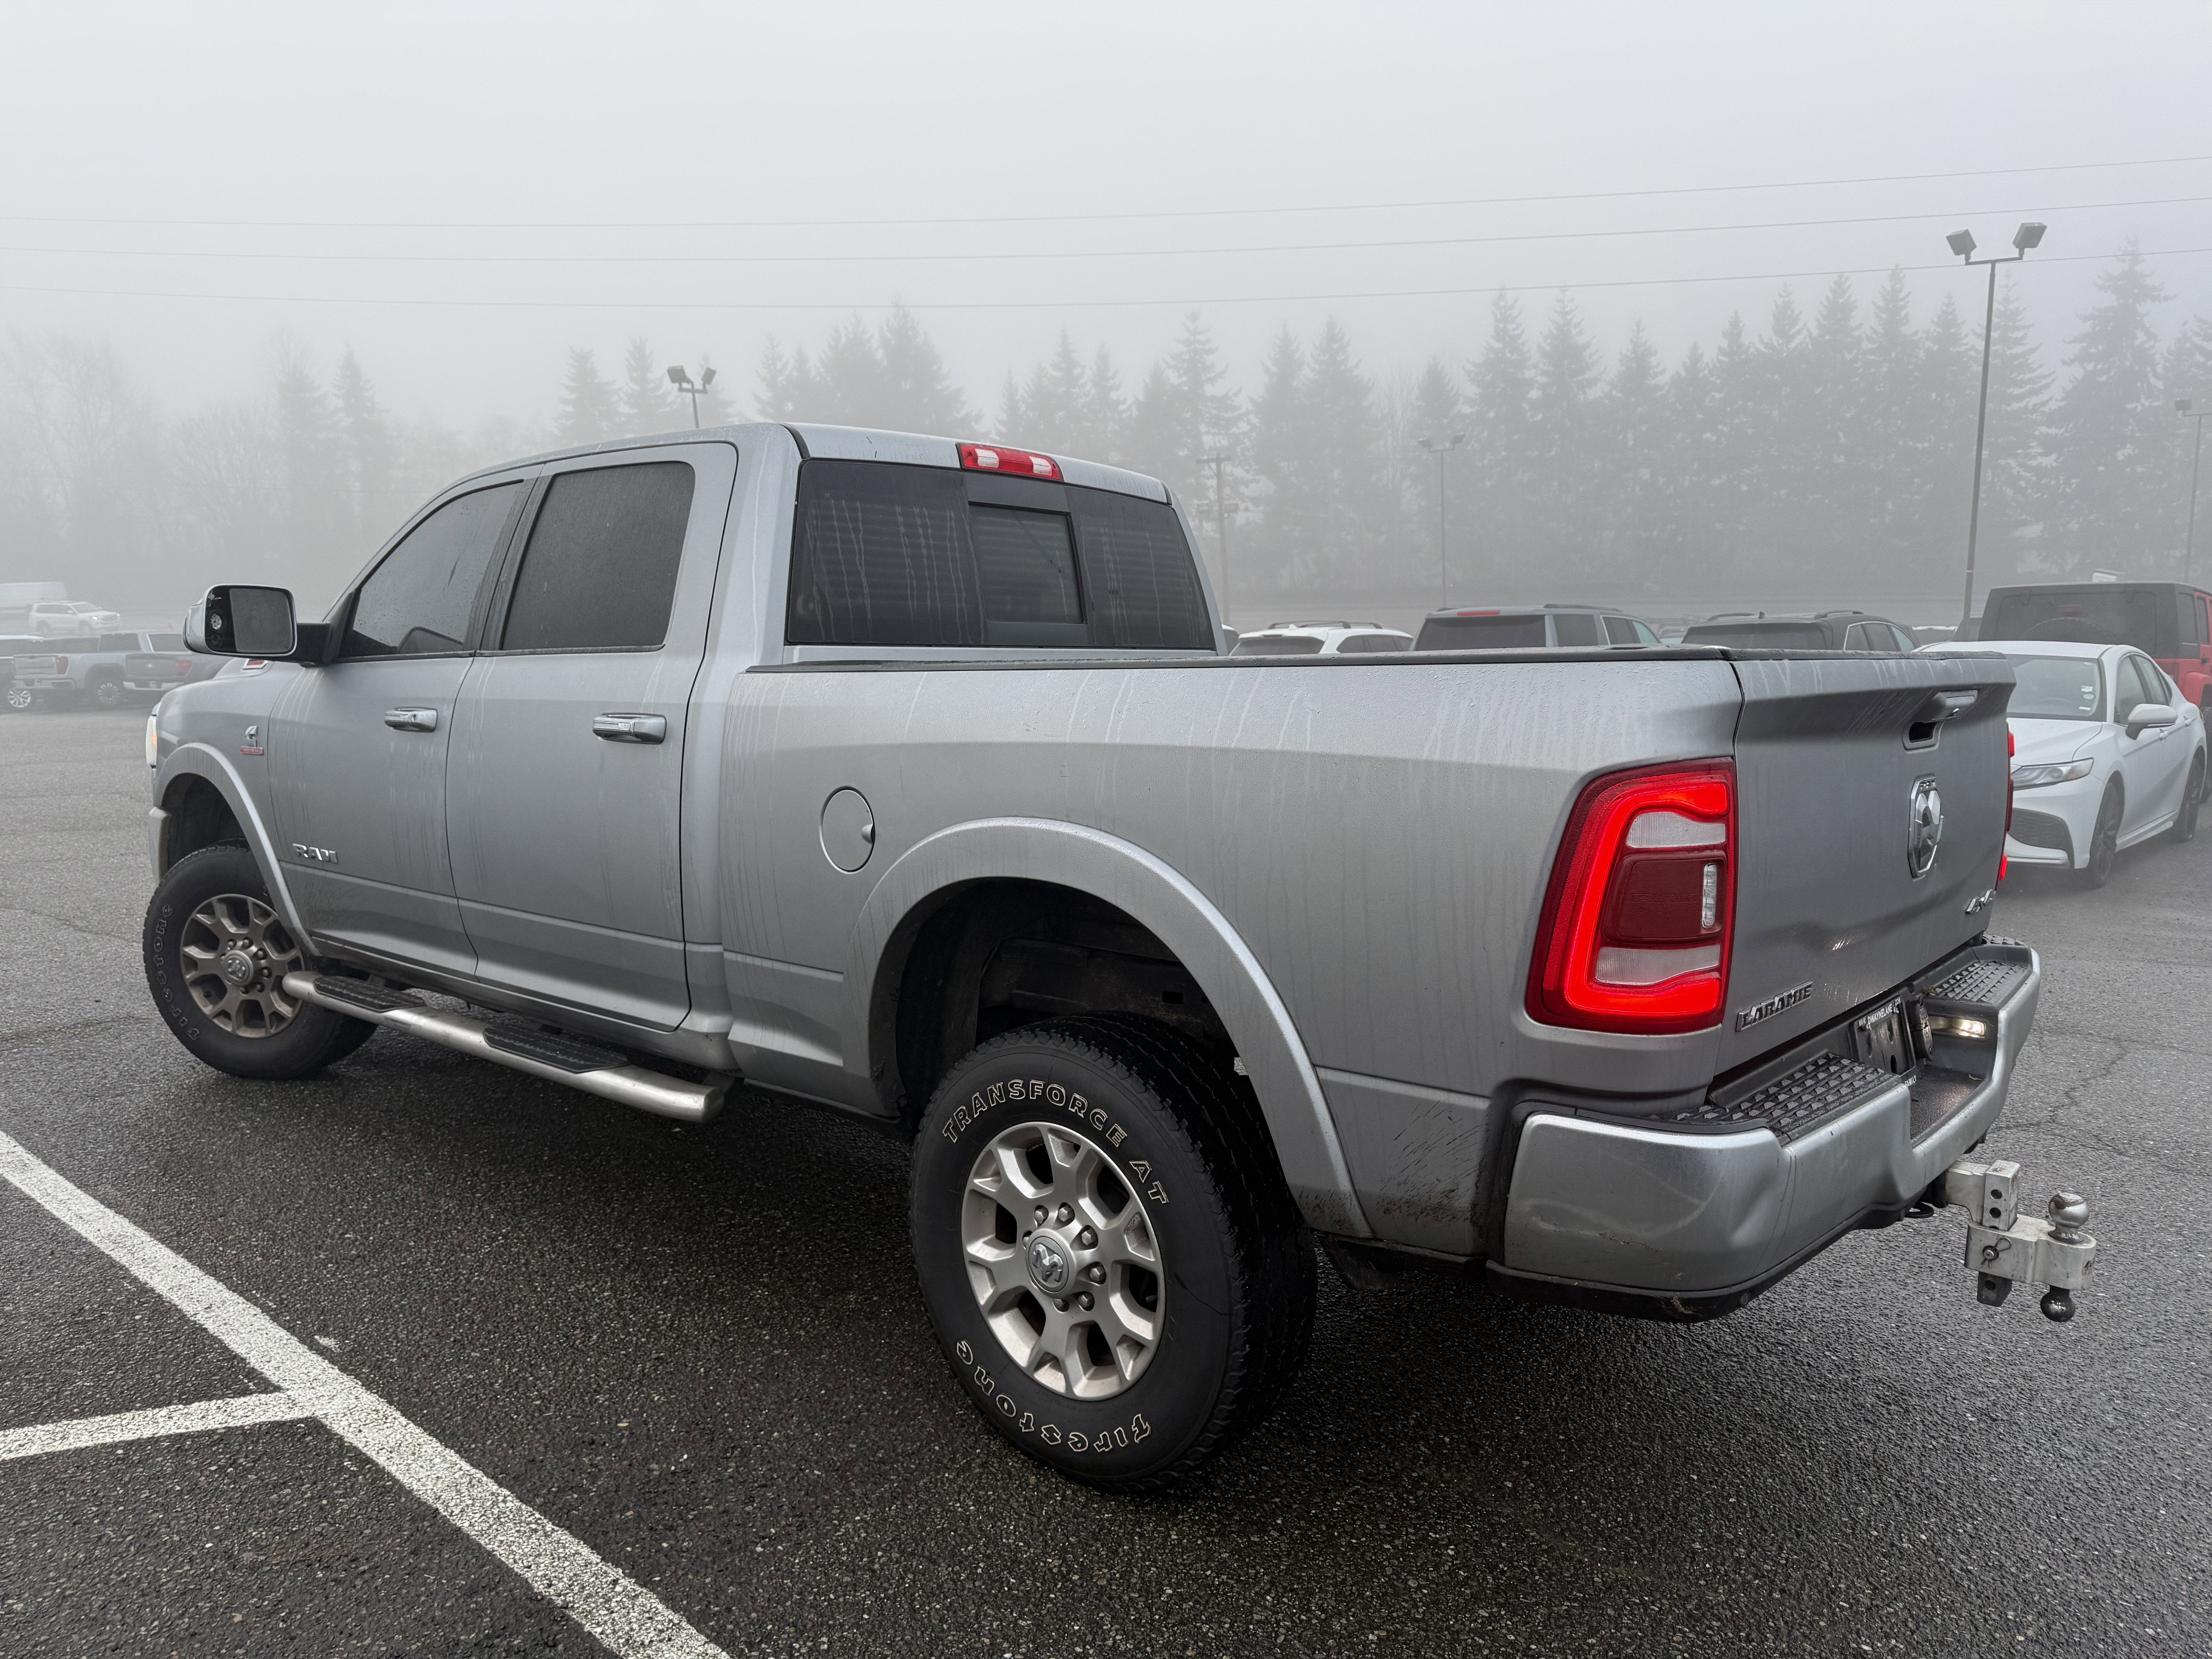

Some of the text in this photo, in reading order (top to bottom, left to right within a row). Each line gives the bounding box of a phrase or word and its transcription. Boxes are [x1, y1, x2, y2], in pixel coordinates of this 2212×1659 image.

[292, 843, 338, 864] RAM
[1735, 981, 1814, 1032] LARAMIE
[1905, 1075, 1917, 1087] FAMILY
[942, 1079, 1170, 1205] TRANSFORCE AT
[955, 1338, 1152, 1454] Firestone
